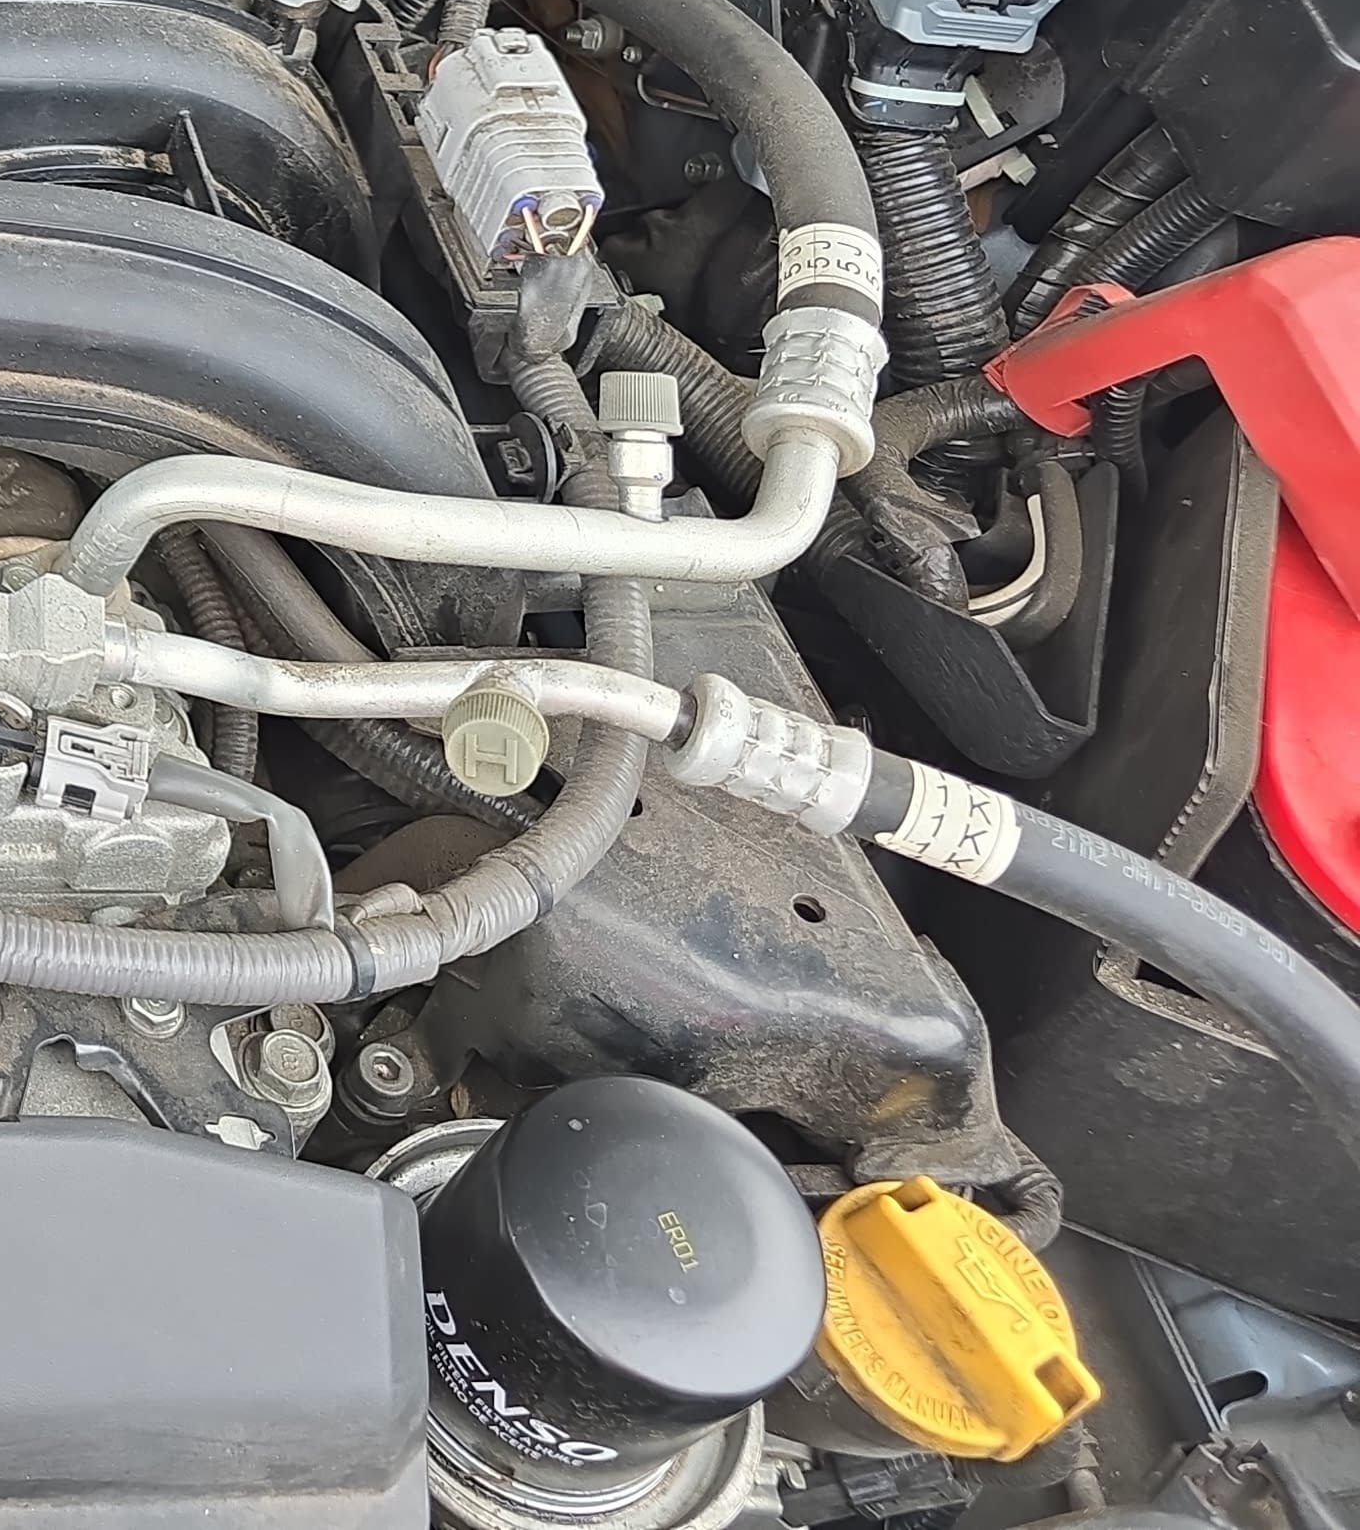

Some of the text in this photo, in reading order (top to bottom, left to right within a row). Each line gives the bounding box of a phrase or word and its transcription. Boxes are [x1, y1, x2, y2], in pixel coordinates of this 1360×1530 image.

[464, 733, 518, 785] H
[657, 1211, 699, 1274] ER01
[425, 1288, 619, 1462] DENSO
[823, 1236, 847, 1281] SEE
[883, 1371, 975, 1432] MANUAL
[431, 1353, 469, 1405] FILTRO
[467, 1403, 491, 1426] DE
[487, 1423, 544, 1462] ACEITE
[434, 1341, 468, 1392] FILTER
[474, 1396, 521, 1438] FILTRE
